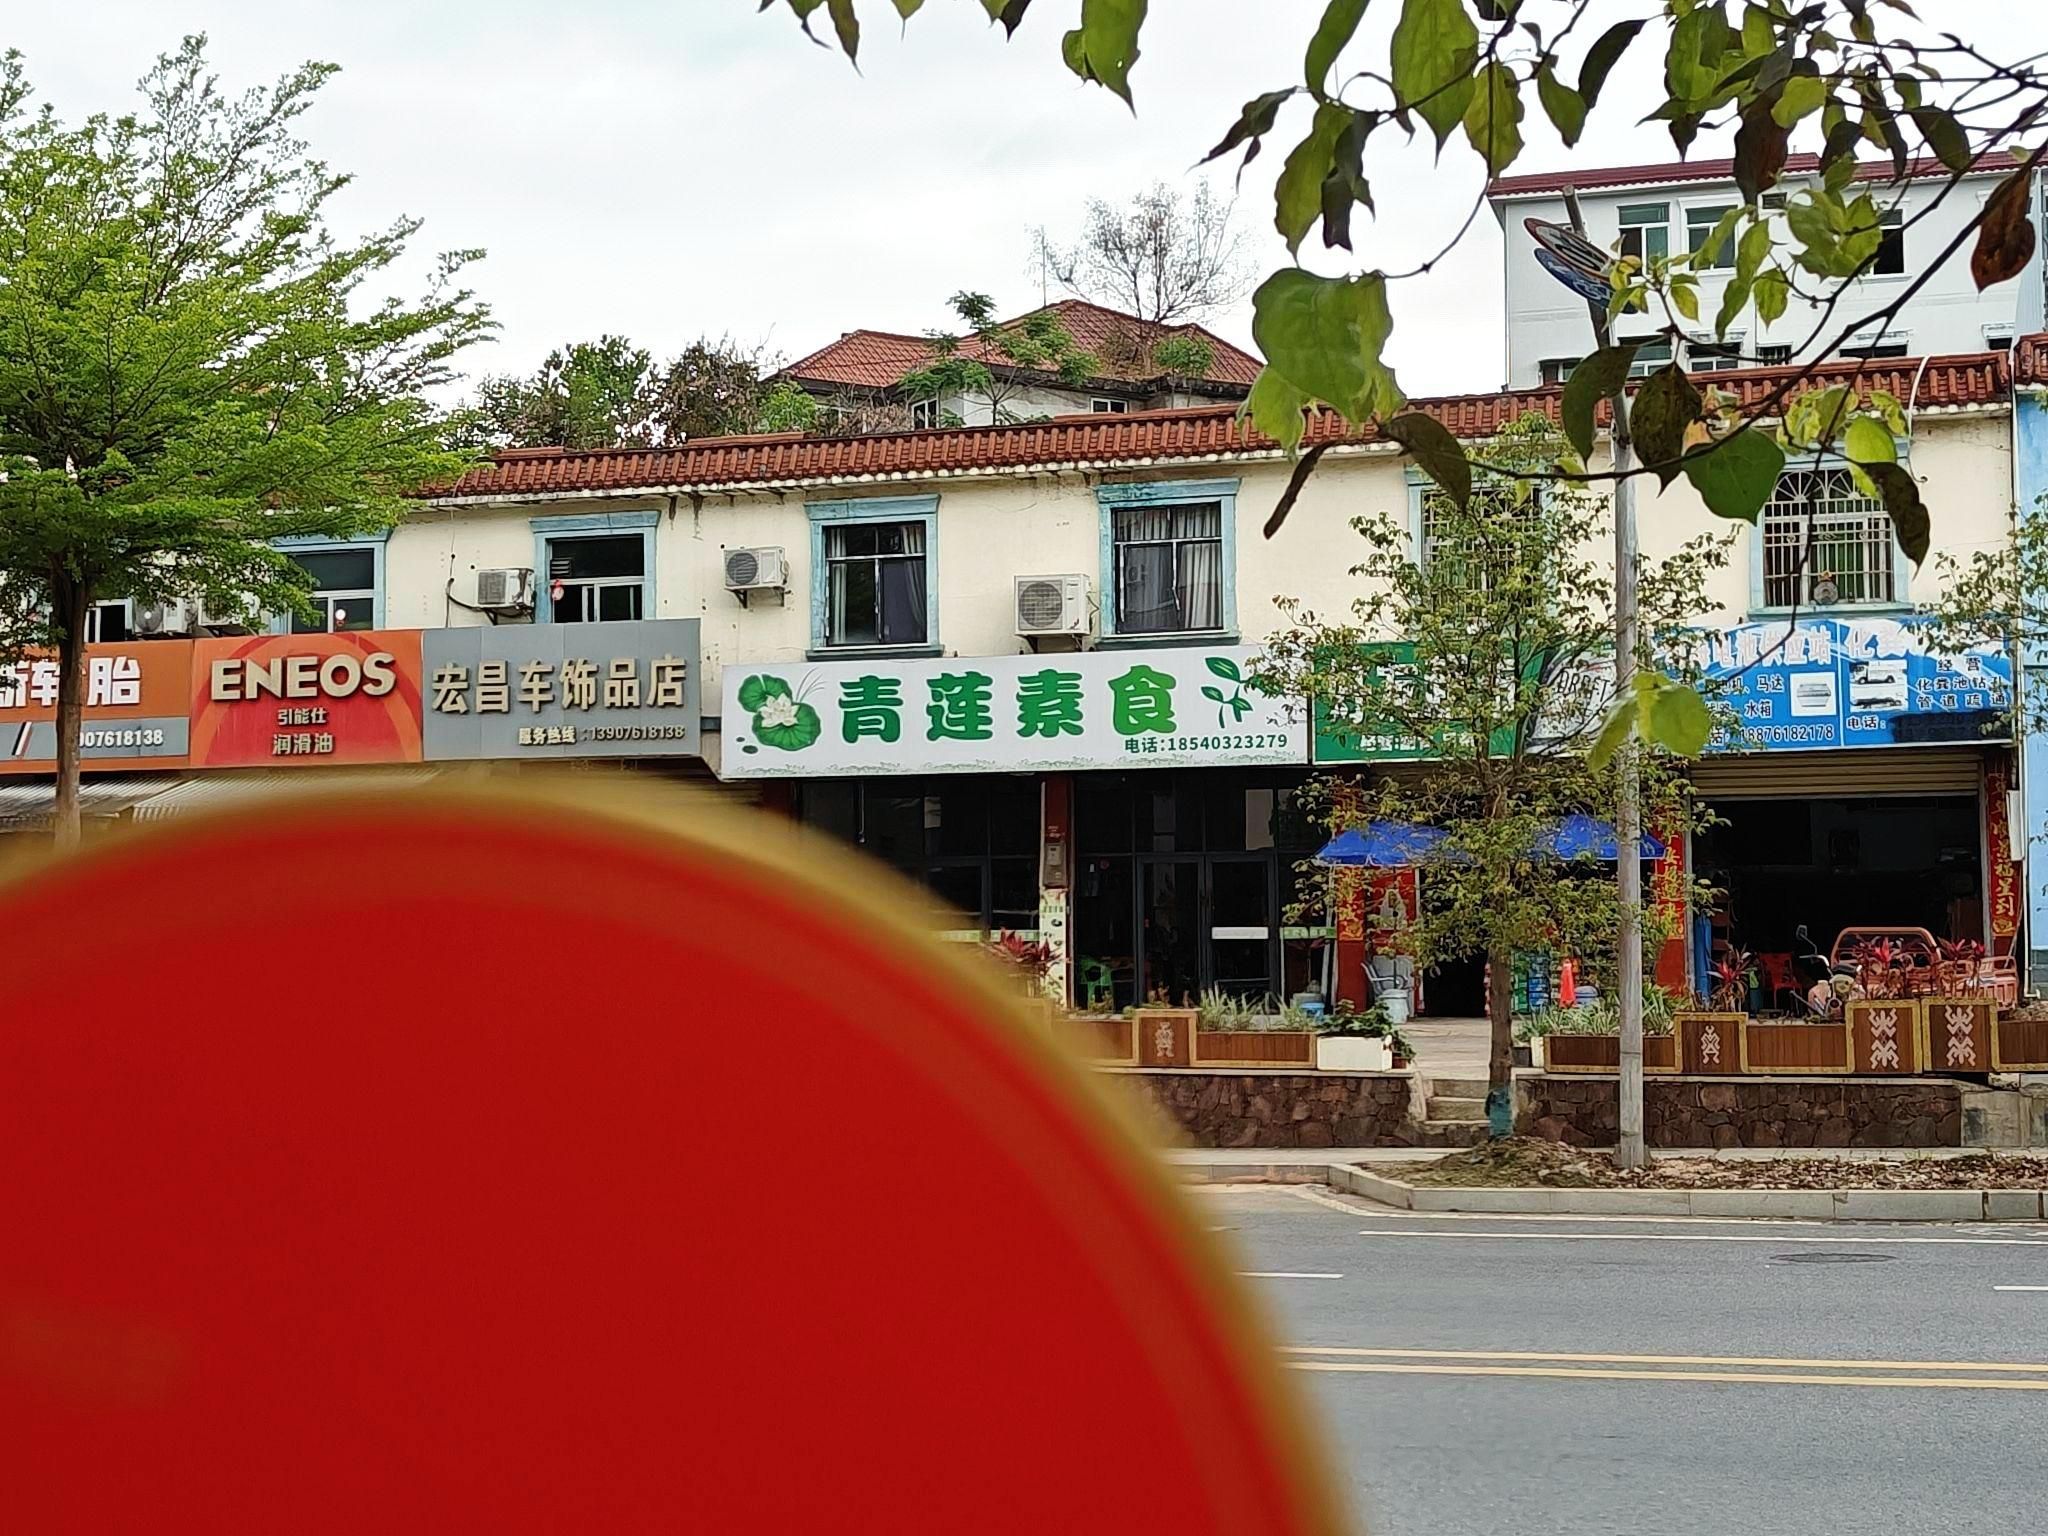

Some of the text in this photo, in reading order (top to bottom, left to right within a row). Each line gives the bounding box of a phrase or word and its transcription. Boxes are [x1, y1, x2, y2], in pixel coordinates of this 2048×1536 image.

[211, 652, 397, 700] ENEOS
[1937, 657, 1982, 673] 经营
[431, 653, 687, 714] 宏昌车饰品店
[838, 664, 1177, 744] 青莲素食
[1917, 692, 2006, 709] 管道疏通
[277, 706, 328, 726] 引能仕
[272, 732, 334, 755] 润滑油
